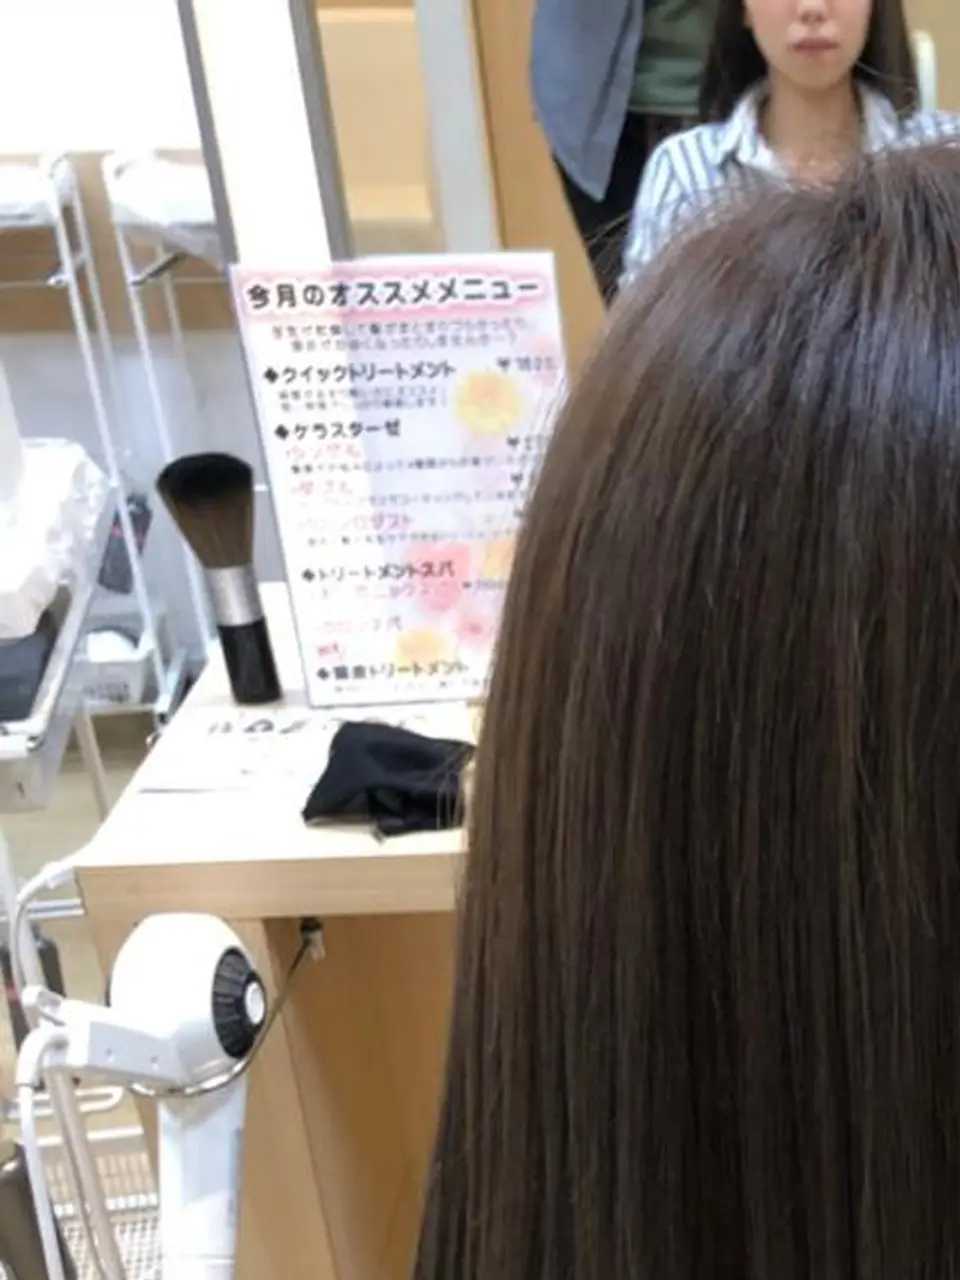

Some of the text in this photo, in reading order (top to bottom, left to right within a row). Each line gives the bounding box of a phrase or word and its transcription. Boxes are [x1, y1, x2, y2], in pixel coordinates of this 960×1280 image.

[247, 277, 539, 309] 今月のオススメメニュー
[281, 359, 456, 384] クイックトリートメント
[294, 418, 401, 440] ケラスターゼ
